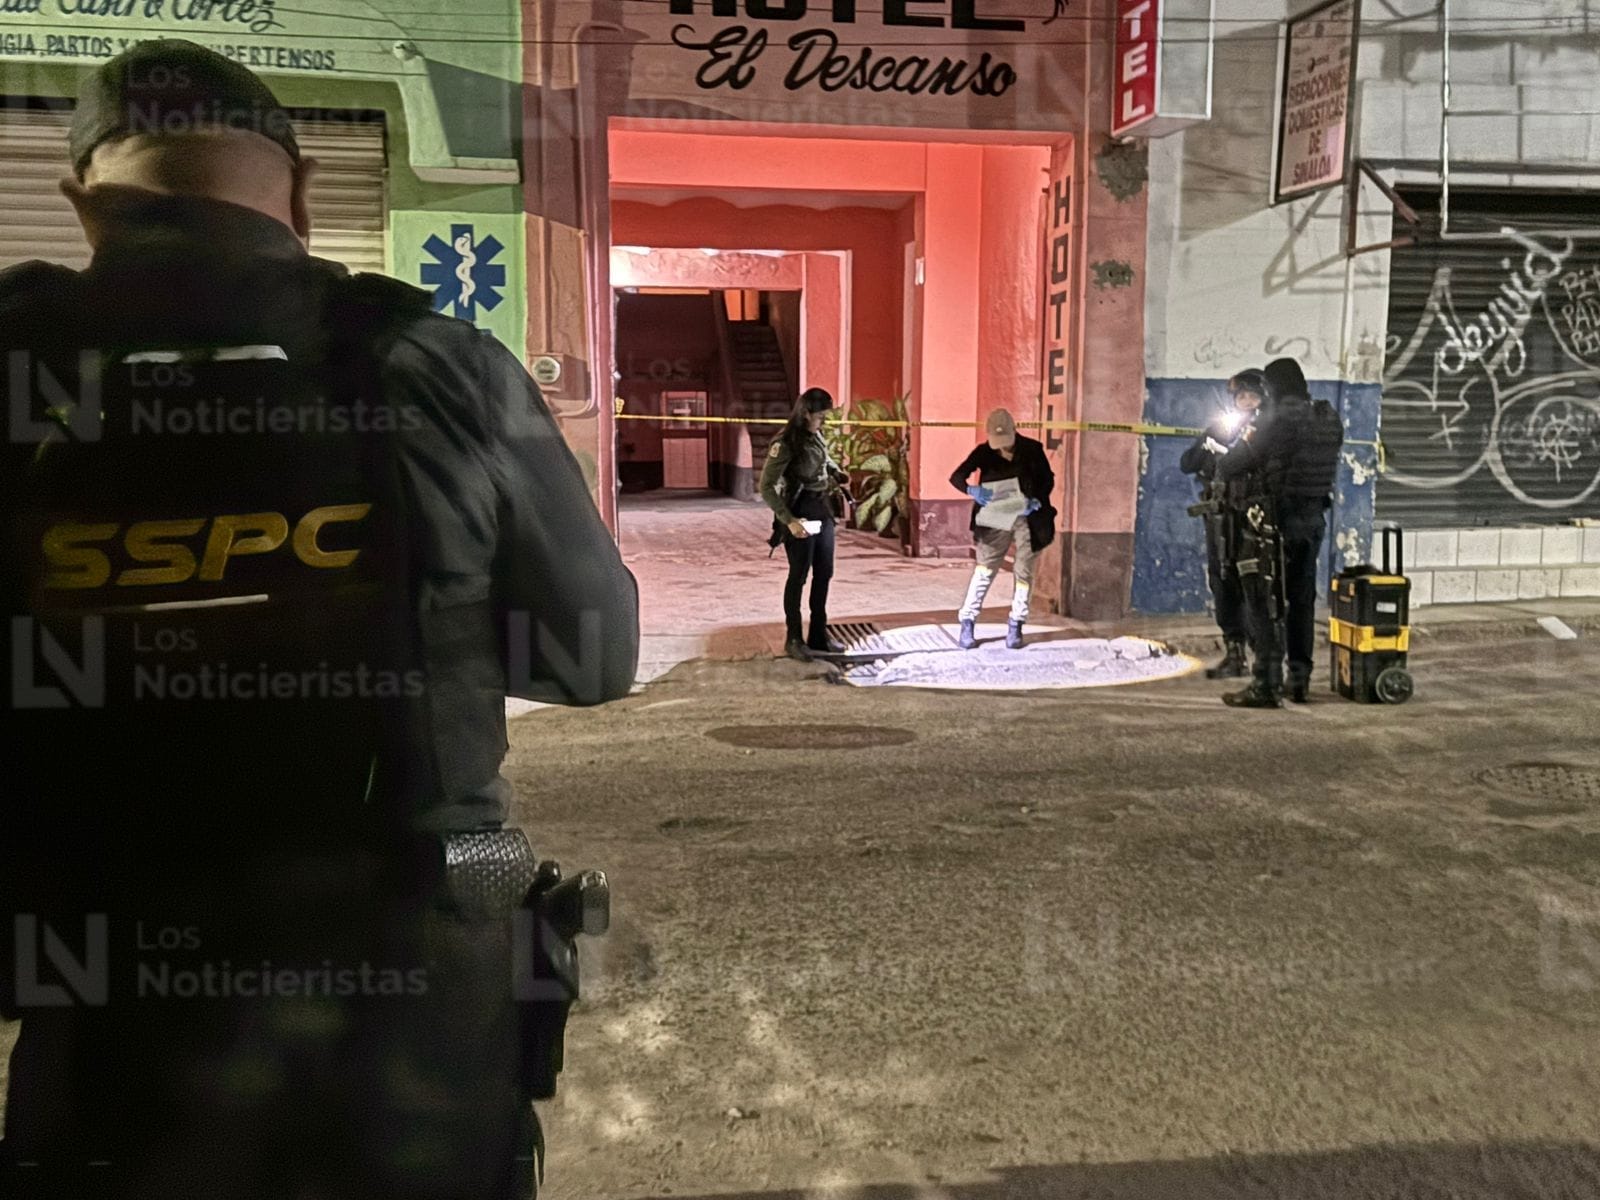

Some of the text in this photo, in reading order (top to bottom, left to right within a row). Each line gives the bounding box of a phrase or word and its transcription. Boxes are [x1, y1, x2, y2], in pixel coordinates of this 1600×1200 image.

[46, 35, 113, 57] PARTOS
[670, 24, 768, 89] El
[784, 29, 1017, 97] Descanso
[1046, 175, 1071, 451] HOTEL
[42, 503, 373, 588] SSPC
